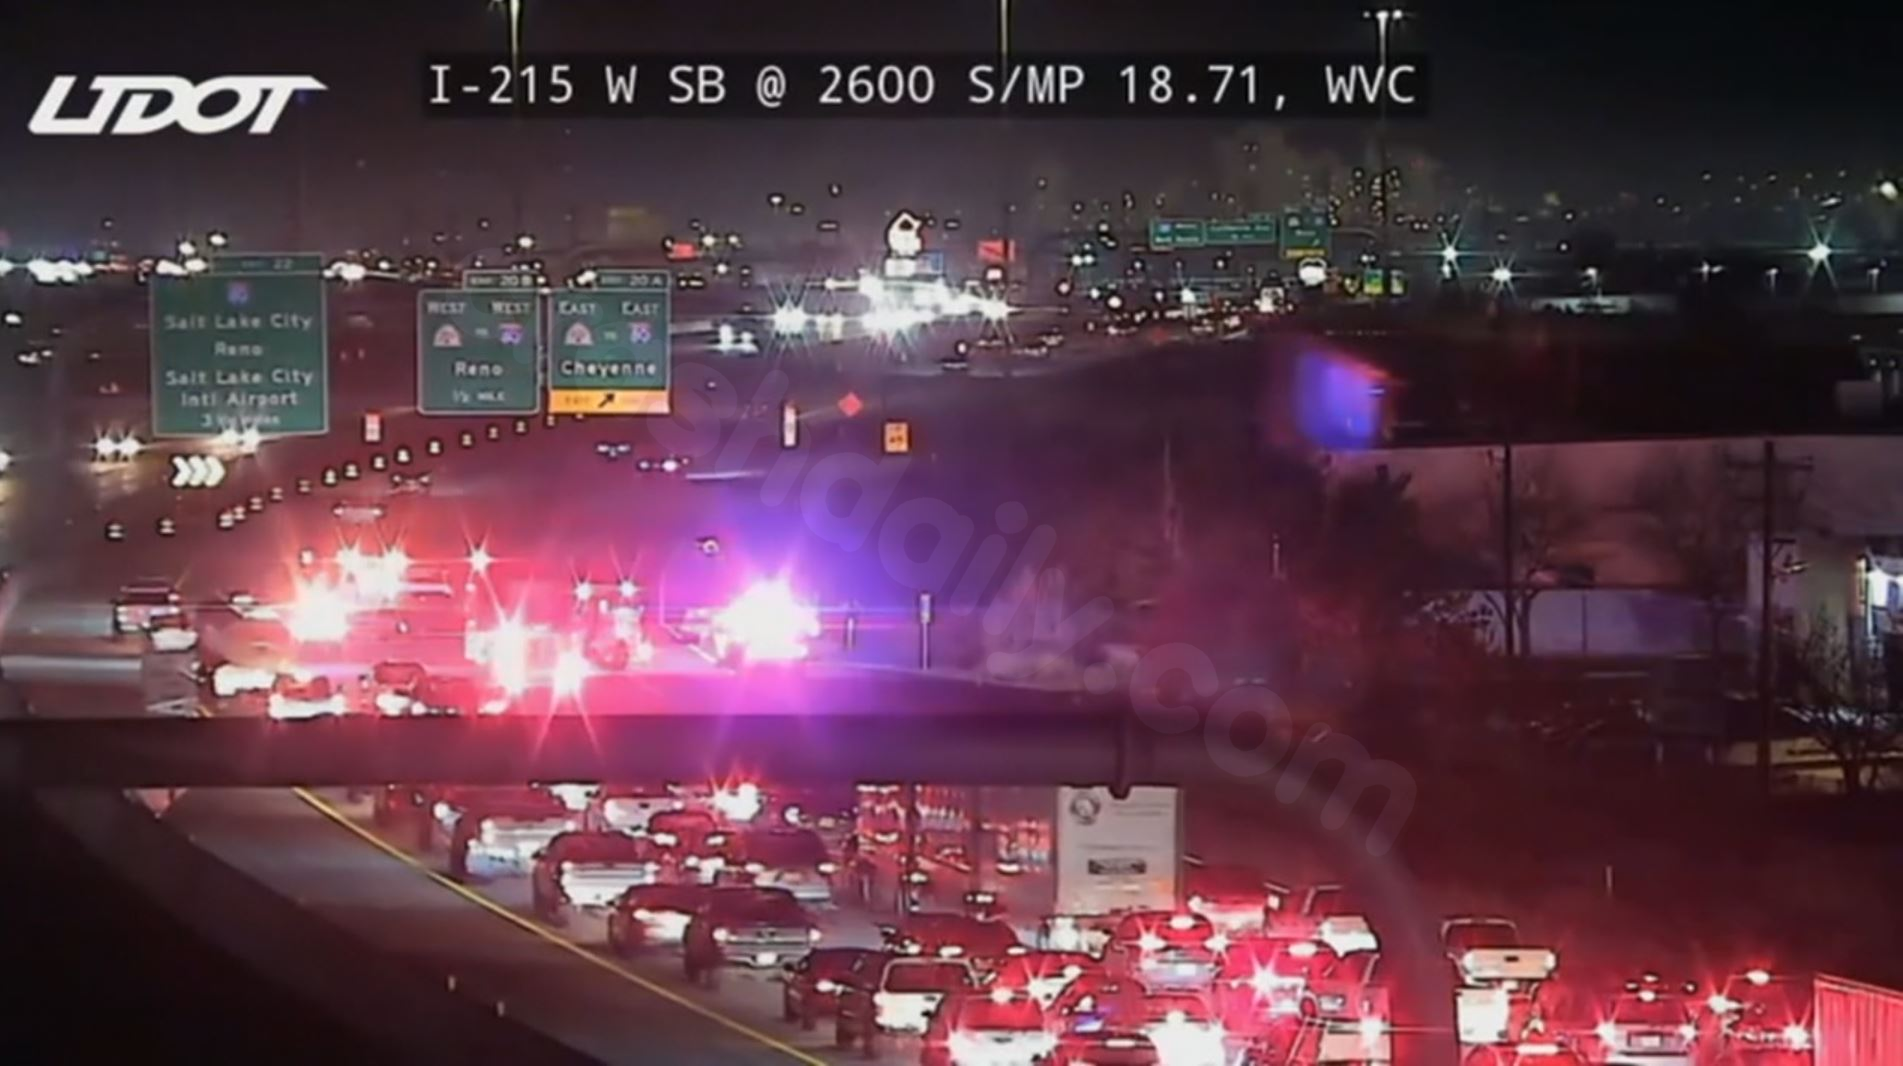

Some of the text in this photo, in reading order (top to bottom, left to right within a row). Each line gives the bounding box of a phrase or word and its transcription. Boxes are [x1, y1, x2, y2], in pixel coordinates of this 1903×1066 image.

[629, 275, 649, 287] 20
[427, 301, 466, 315] WEST
[491, 301, 530, 315] WEST
[559, 301, 596, 315] EAST
[621, 301, 659, 315] EAST
[163, 313, 314, 331] Salt Lake City
[214, 341, 264, 357] Reno
[454, 360, 504, 377] Reno
[561, 360, 657, 379] Cheyenne
[165, 368, 314, 388] Salt Lake City
[226, 391, 299, 409] Airport
